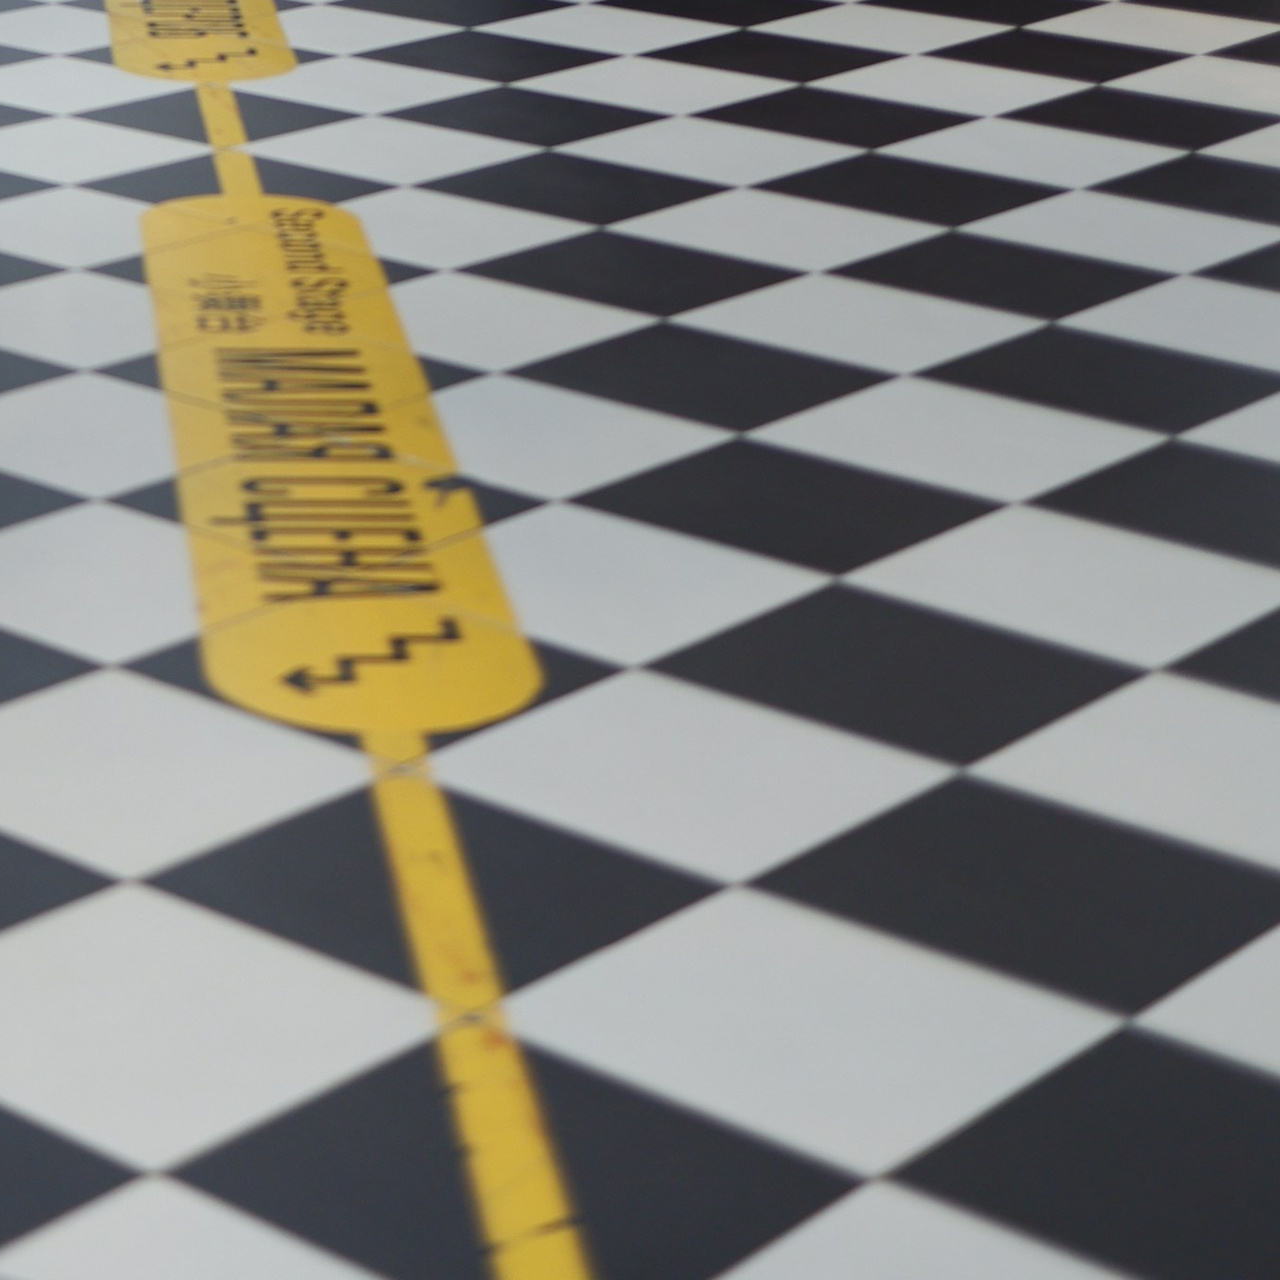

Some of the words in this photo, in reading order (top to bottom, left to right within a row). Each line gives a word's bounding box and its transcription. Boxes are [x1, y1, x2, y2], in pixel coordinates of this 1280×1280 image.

[271, 207, 342, 274] Second
[286, 277, 349, 336] Stage
[214, 347, 396, 462] МАЛАЯ
[209, 476, 441, 603] СЦЕНА
